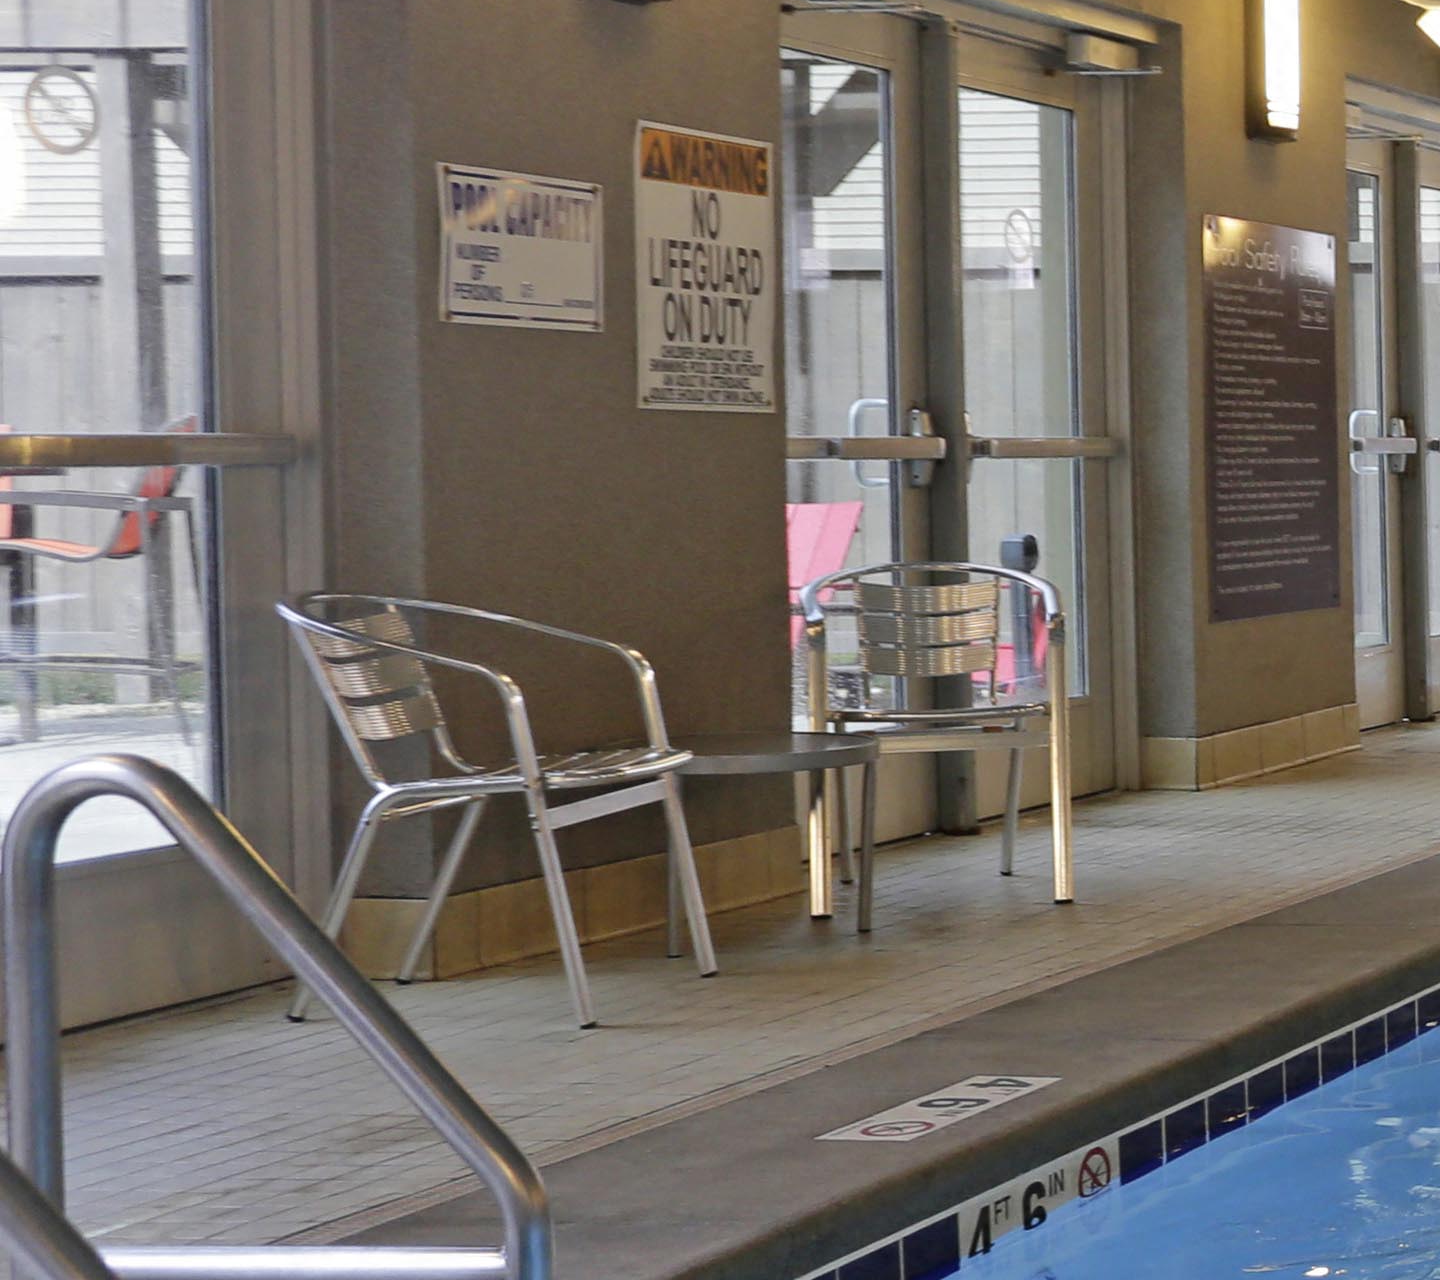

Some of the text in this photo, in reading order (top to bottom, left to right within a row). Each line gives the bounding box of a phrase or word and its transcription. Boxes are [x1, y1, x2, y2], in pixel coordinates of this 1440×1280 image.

[672, 136, 768, 194] WARNING
[451, 182, 500, 233] POOL
[692, 190, 720, 239] NO
[649, 237, 763, 296] LIFEGUARD
[1244, 238, 1287, 280] Safety
[664, 293, 752, 346] ON DUTY
[968, 1169, 1065, 1258] 4 FT 6 IN
